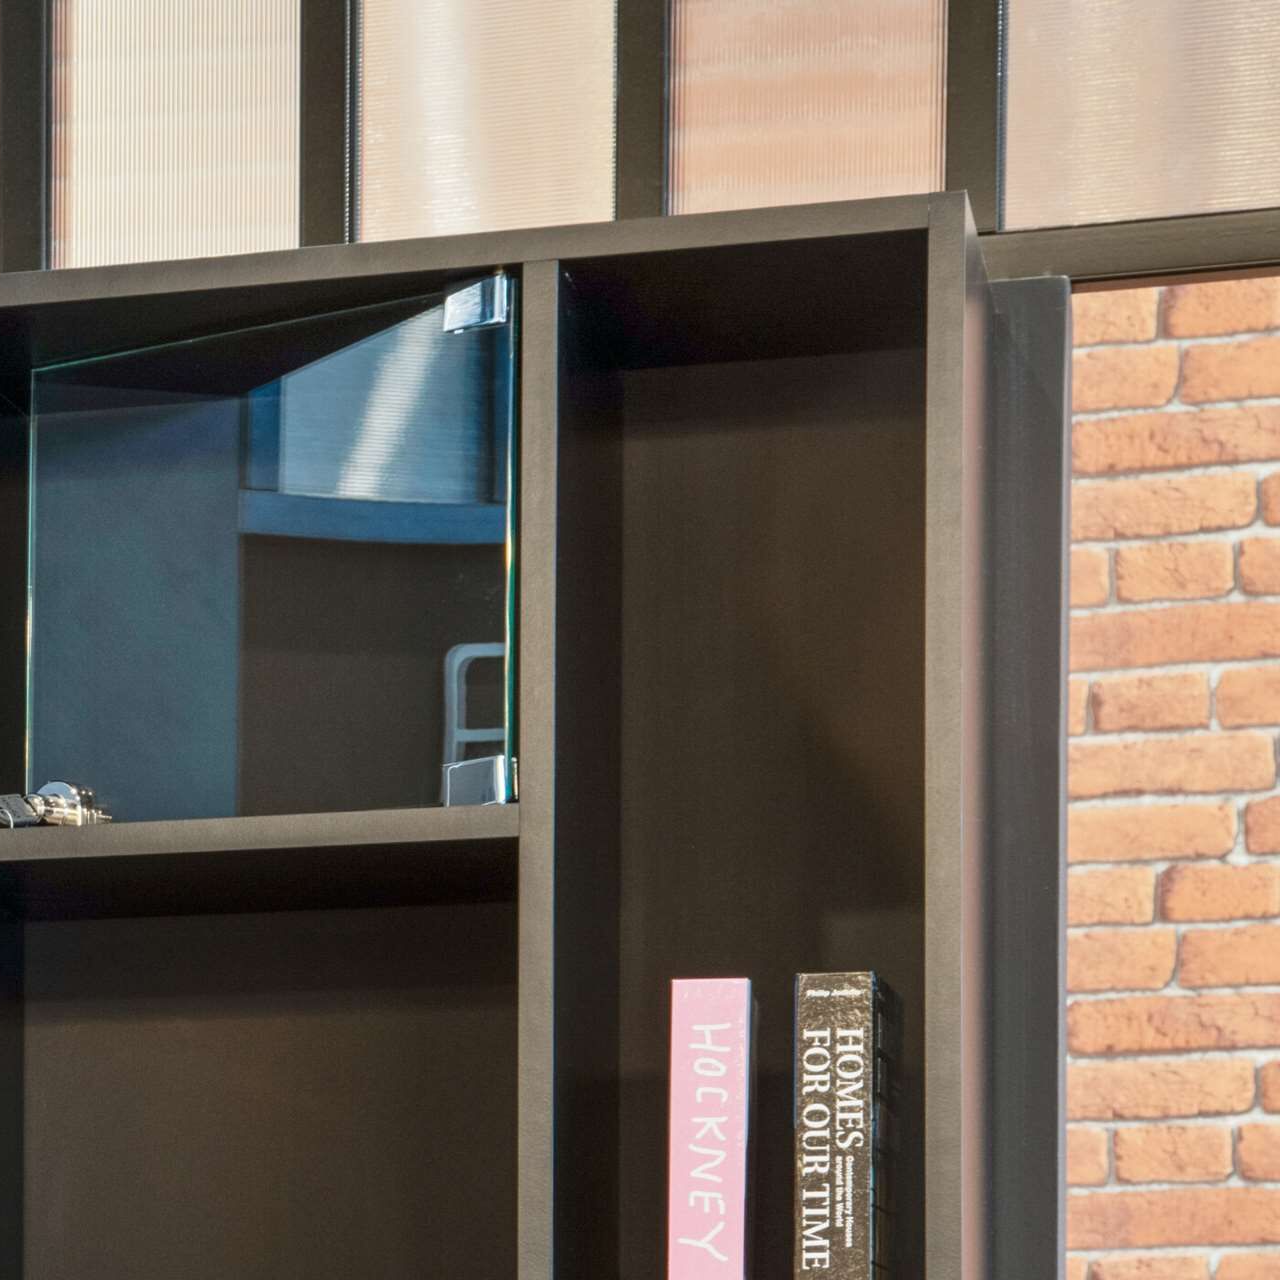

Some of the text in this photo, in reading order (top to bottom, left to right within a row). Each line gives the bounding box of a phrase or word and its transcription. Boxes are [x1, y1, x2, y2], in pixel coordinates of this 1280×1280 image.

[677, 1022, 732, 1263] HOCKNEY
[802, 1027, 831, 1270] FOR OUR TIME
[836, 1027, 864, 1150] HOMES
